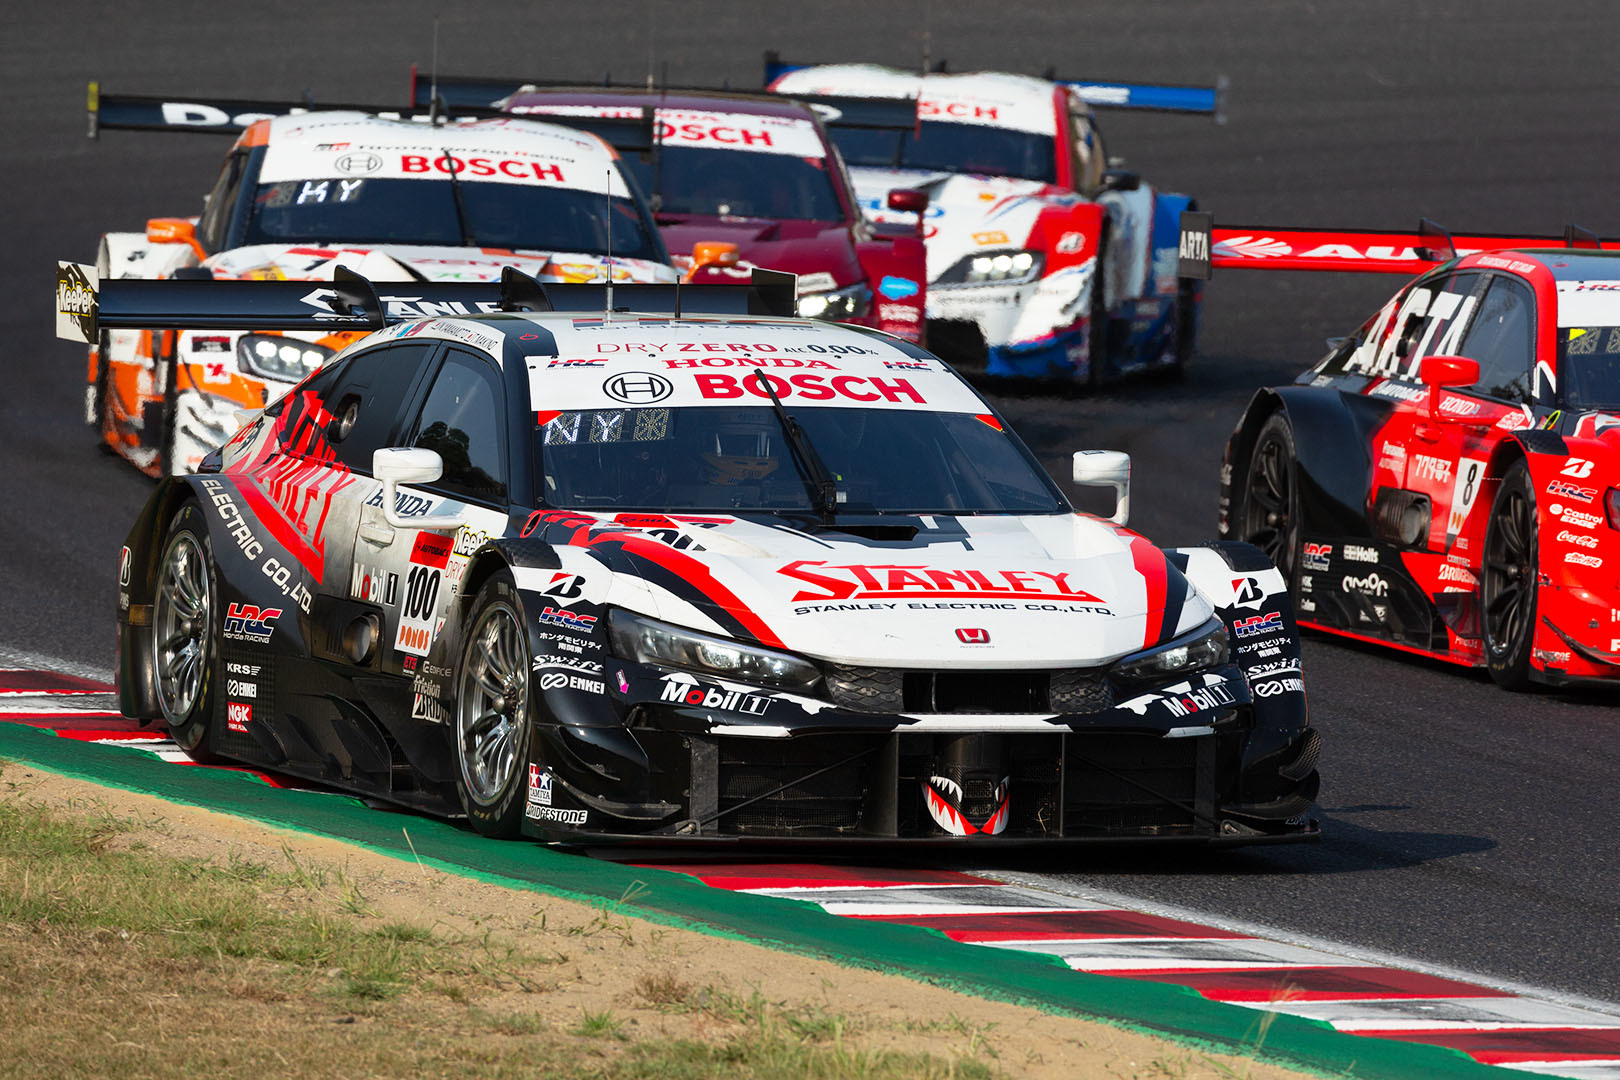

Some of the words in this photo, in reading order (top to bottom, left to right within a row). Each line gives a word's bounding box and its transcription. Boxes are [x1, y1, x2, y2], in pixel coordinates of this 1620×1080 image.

[654, 121, 773, 146] OSCH
[402, 154, 566, 182] BOSCH
[661, 357, 842, 371] HONDA
[693, 373, 928, 404] BOSCH
[202, 480, 265, 562] ELECTRIC
[1563, 508, 1604, 525] Castrol
[351, 562, 384, 604] Mobil
[404, 565, 442, 621] 100
[777, 560, 1107, 604] STANLEY
[223, 602, 283, 637] HRC
[539, 607, 598, 631] HRC
[794, 603, 897, 616] STANLEY
[907, 602, 1017, 612] ELECTRIC
[1234, 612, 1283, 636] HRC
[399, 625, 430, 652] PONOS
[539, 632, 602, 651] ホンダモビリティ
[1237, 637, 1293, 655] ホンダモビリティ
[227, 662, 251, 675] KRS
[569, 675, 605, 695] ENKEI
[660, 683, 742, 712] Mobil
[228, 704, 250, 722] NGK
[1161, 686, 1220, 718] Mobil
